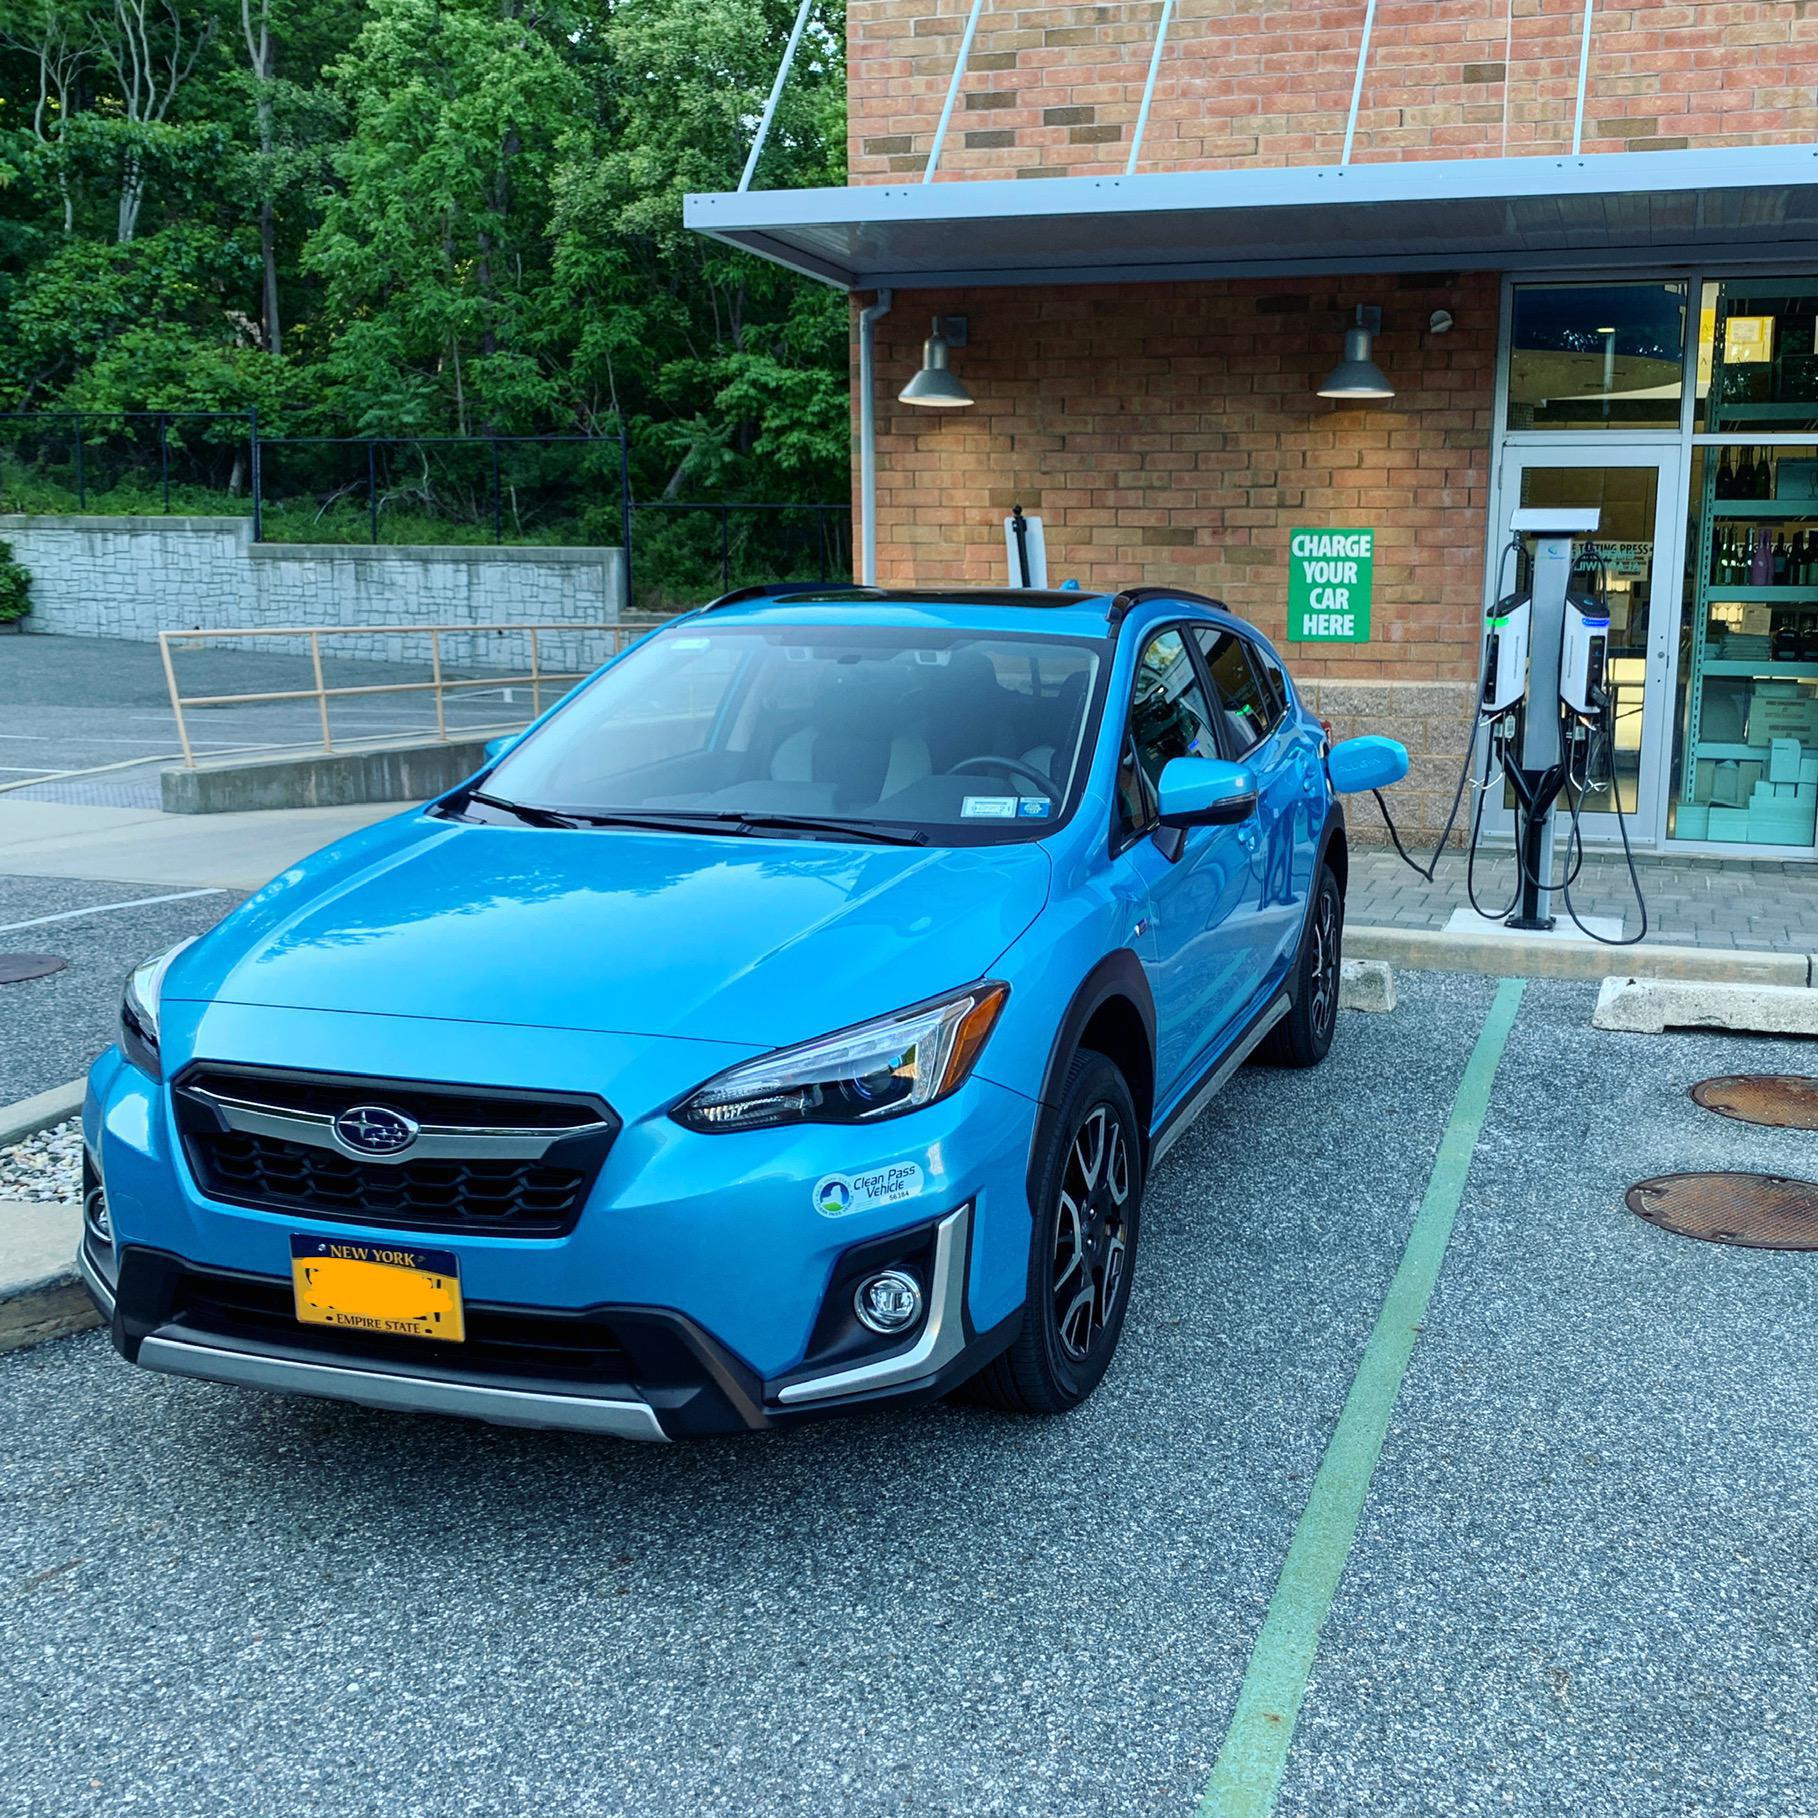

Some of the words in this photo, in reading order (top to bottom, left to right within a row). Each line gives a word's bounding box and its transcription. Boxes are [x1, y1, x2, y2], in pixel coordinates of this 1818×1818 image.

[1291, 534, 1371, 558] CHARGE
[1303, 561, 1358, 584] YOUR
[1309, 587, 1350, 610] CAR
[1302, 614, 1355, 636] HERE
[853, 1174, 884, 1191] Clean
[888, 1165, 916, 1181] Pass
[866, 1179, 905, 1199] Vehicle
[330, 1244, 370, 1260] NEW
[372, 1249, 417, 1268] YORK
[336, 1313, 382, 1329] EMPIRE
[385, 1321, 421, 1334] STATE
